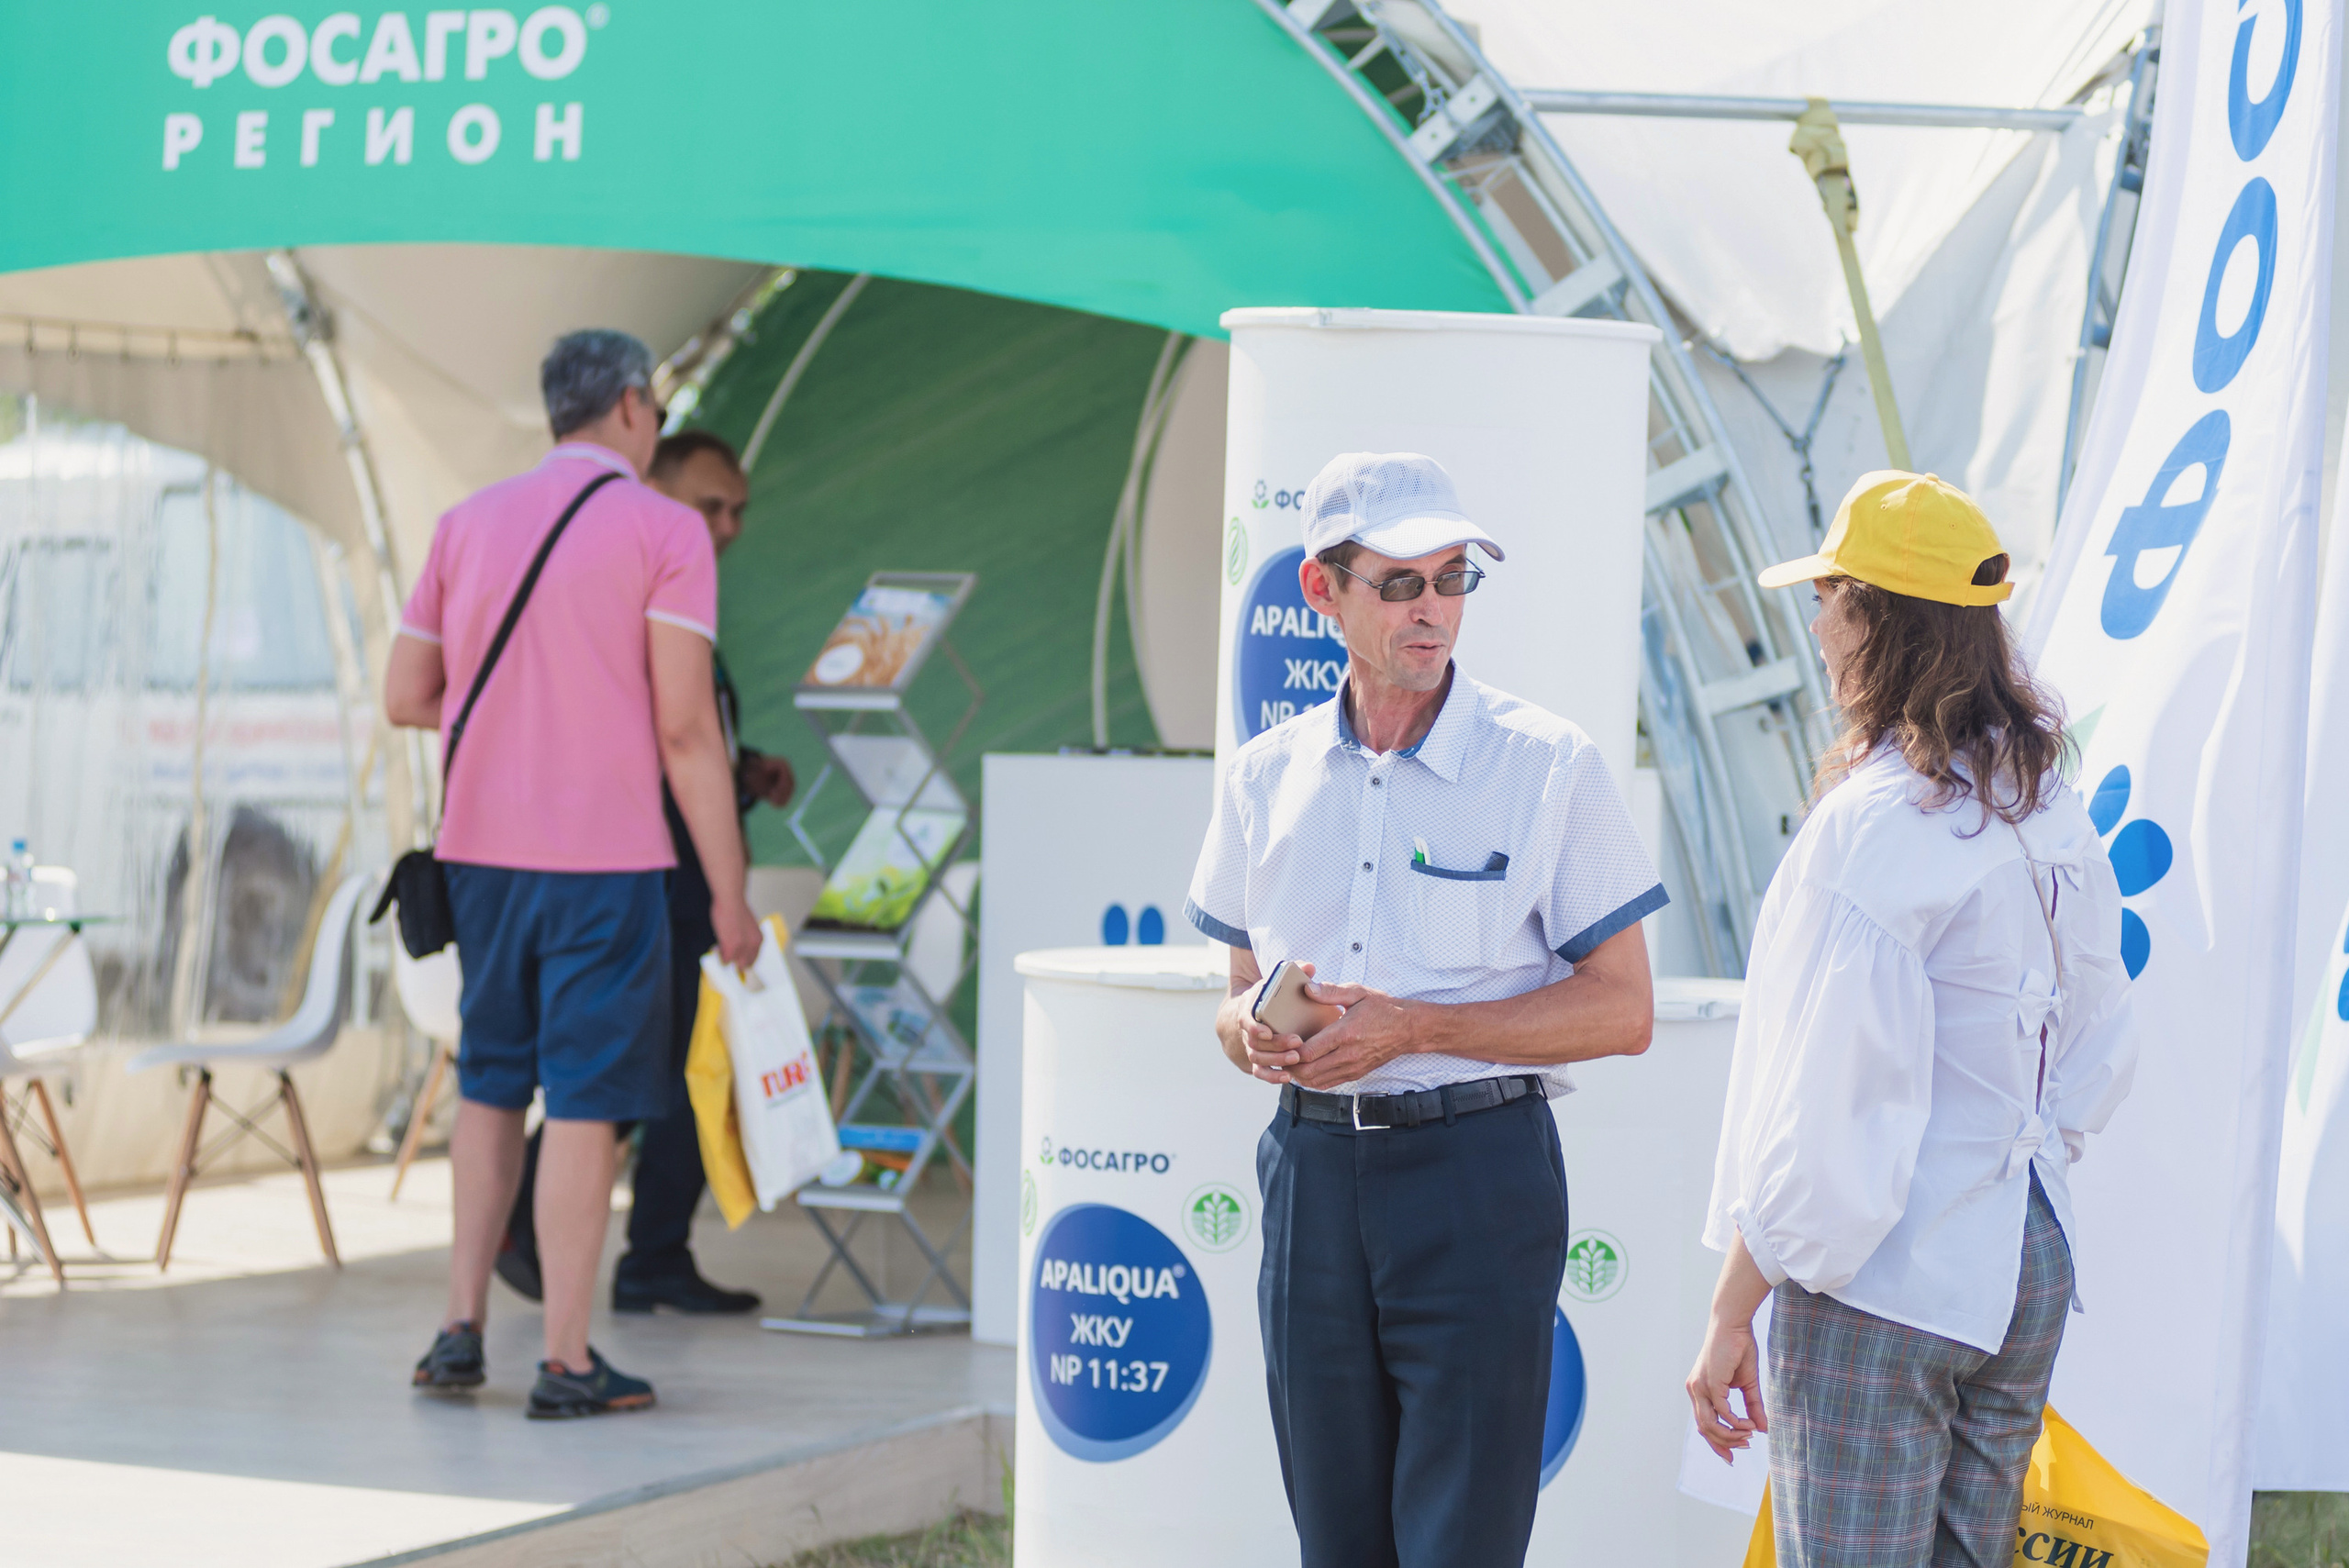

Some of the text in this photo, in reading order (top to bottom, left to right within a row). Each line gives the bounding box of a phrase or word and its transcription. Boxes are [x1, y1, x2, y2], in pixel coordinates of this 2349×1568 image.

[162, 102, 584, 171] РЕГИОН
[2100, 0, 2301, 639] ФОС
[1283, 658, 1350, 691] ЖКУ
[1059, 1147, 1170, 1173] ФОСАГРО
[1070, 1313, 1133, 1349] ЖКУ
[1050, 1353, 1170, 1394] NP 11:37
[2042, 1506, 2095, 1529] ЖУРНАЛ
[2015, 1527, 2114, 1568] СИИ
